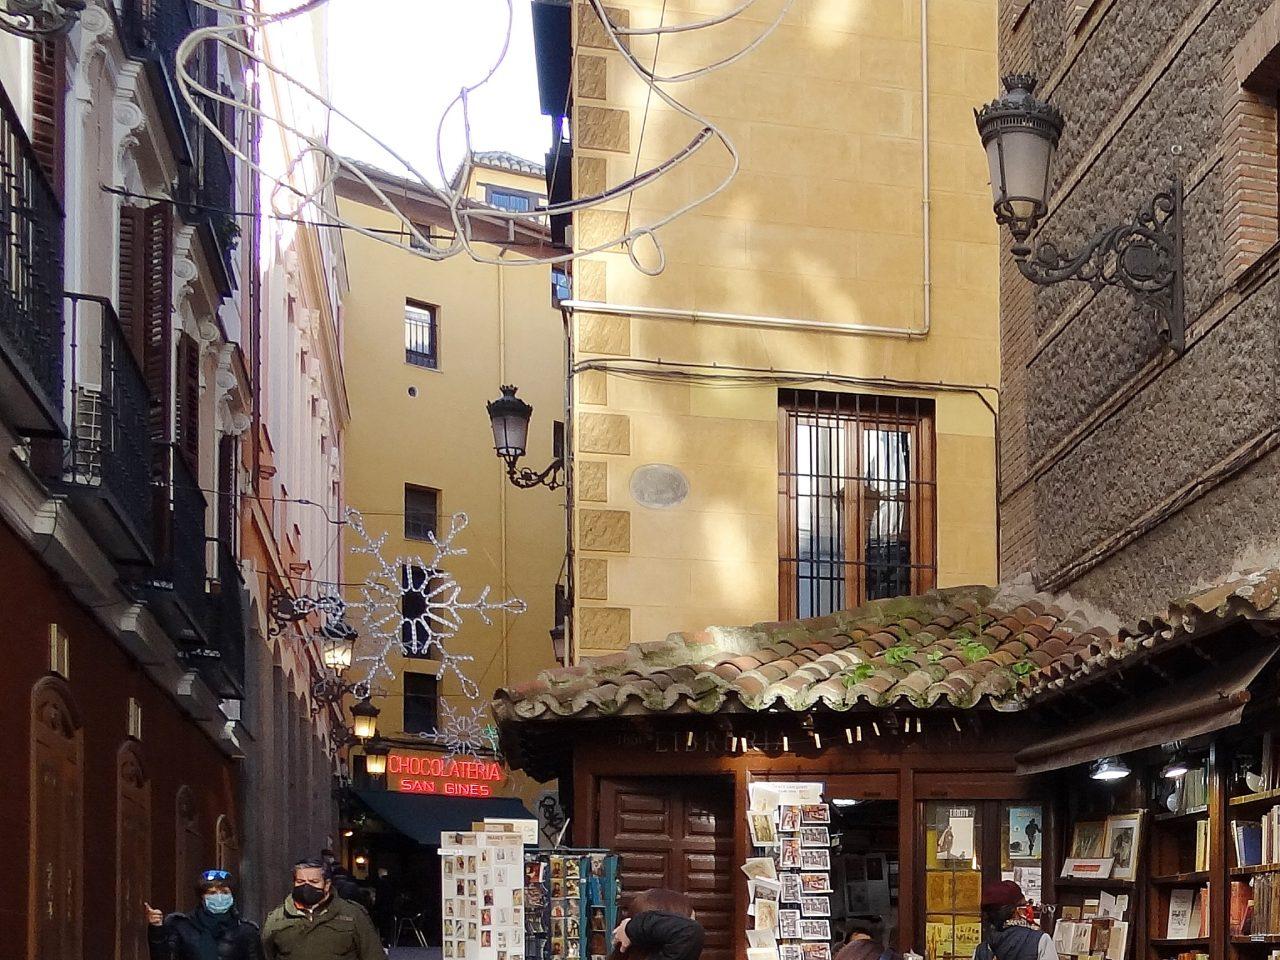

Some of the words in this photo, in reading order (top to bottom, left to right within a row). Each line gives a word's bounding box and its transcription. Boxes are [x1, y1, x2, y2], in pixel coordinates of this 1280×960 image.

[388, 755, 500, 781] CHOCOLATERIA
[400, 779, 436, 792] SAN
[444, 782, 489, 796] GINES
